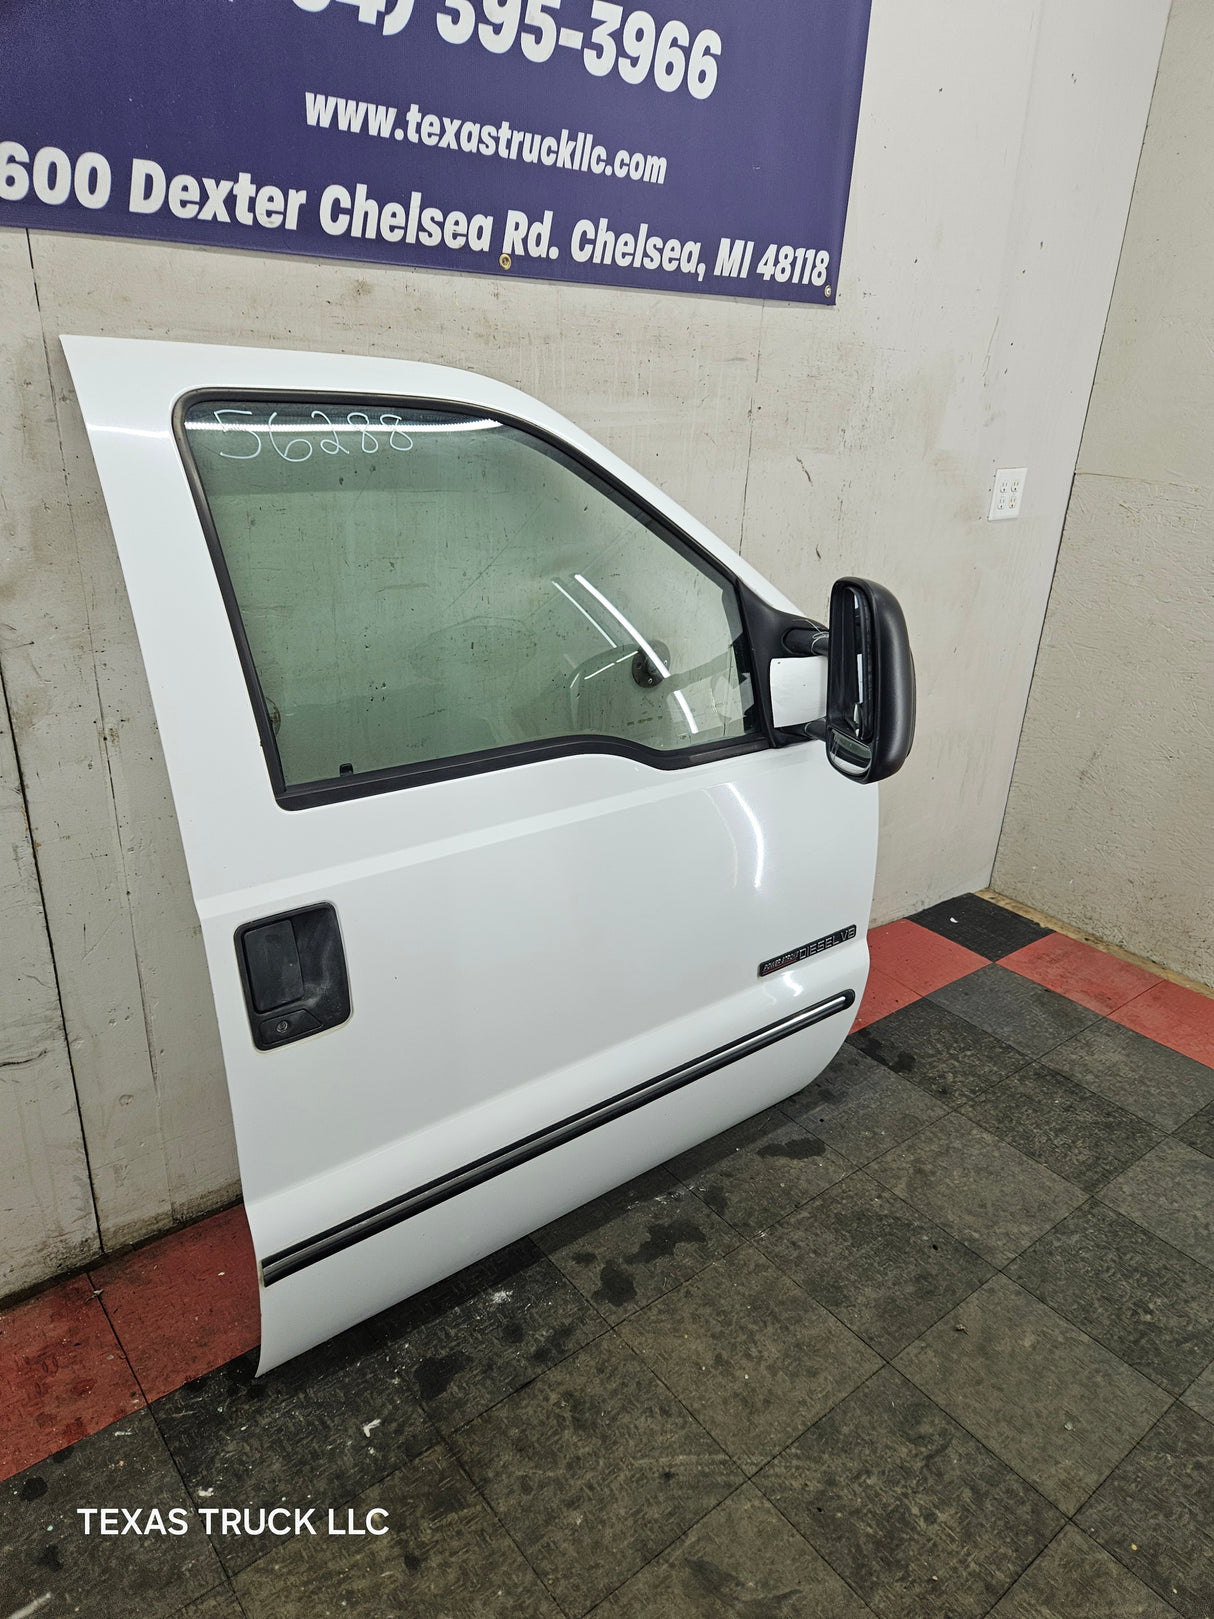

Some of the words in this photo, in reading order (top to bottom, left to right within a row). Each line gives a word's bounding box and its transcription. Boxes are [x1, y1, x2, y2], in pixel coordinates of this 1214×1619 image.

[305, 91, 668, 185] www.texastruckllc.com
[0, 141, 112, 209] 600
[129, 158, 307, 231] Dexter
[319, 183, 494, 252] Chelsea
[502, 209, 560, 260] Rd.
[570, 217, 706, 282] Chelsea,
[713, 237, 755, 279] MI
[756, 243, 830, 287] 48118
[212, 408, 414, 463] 56288
[799, 935, 840, 960] DIESEL
